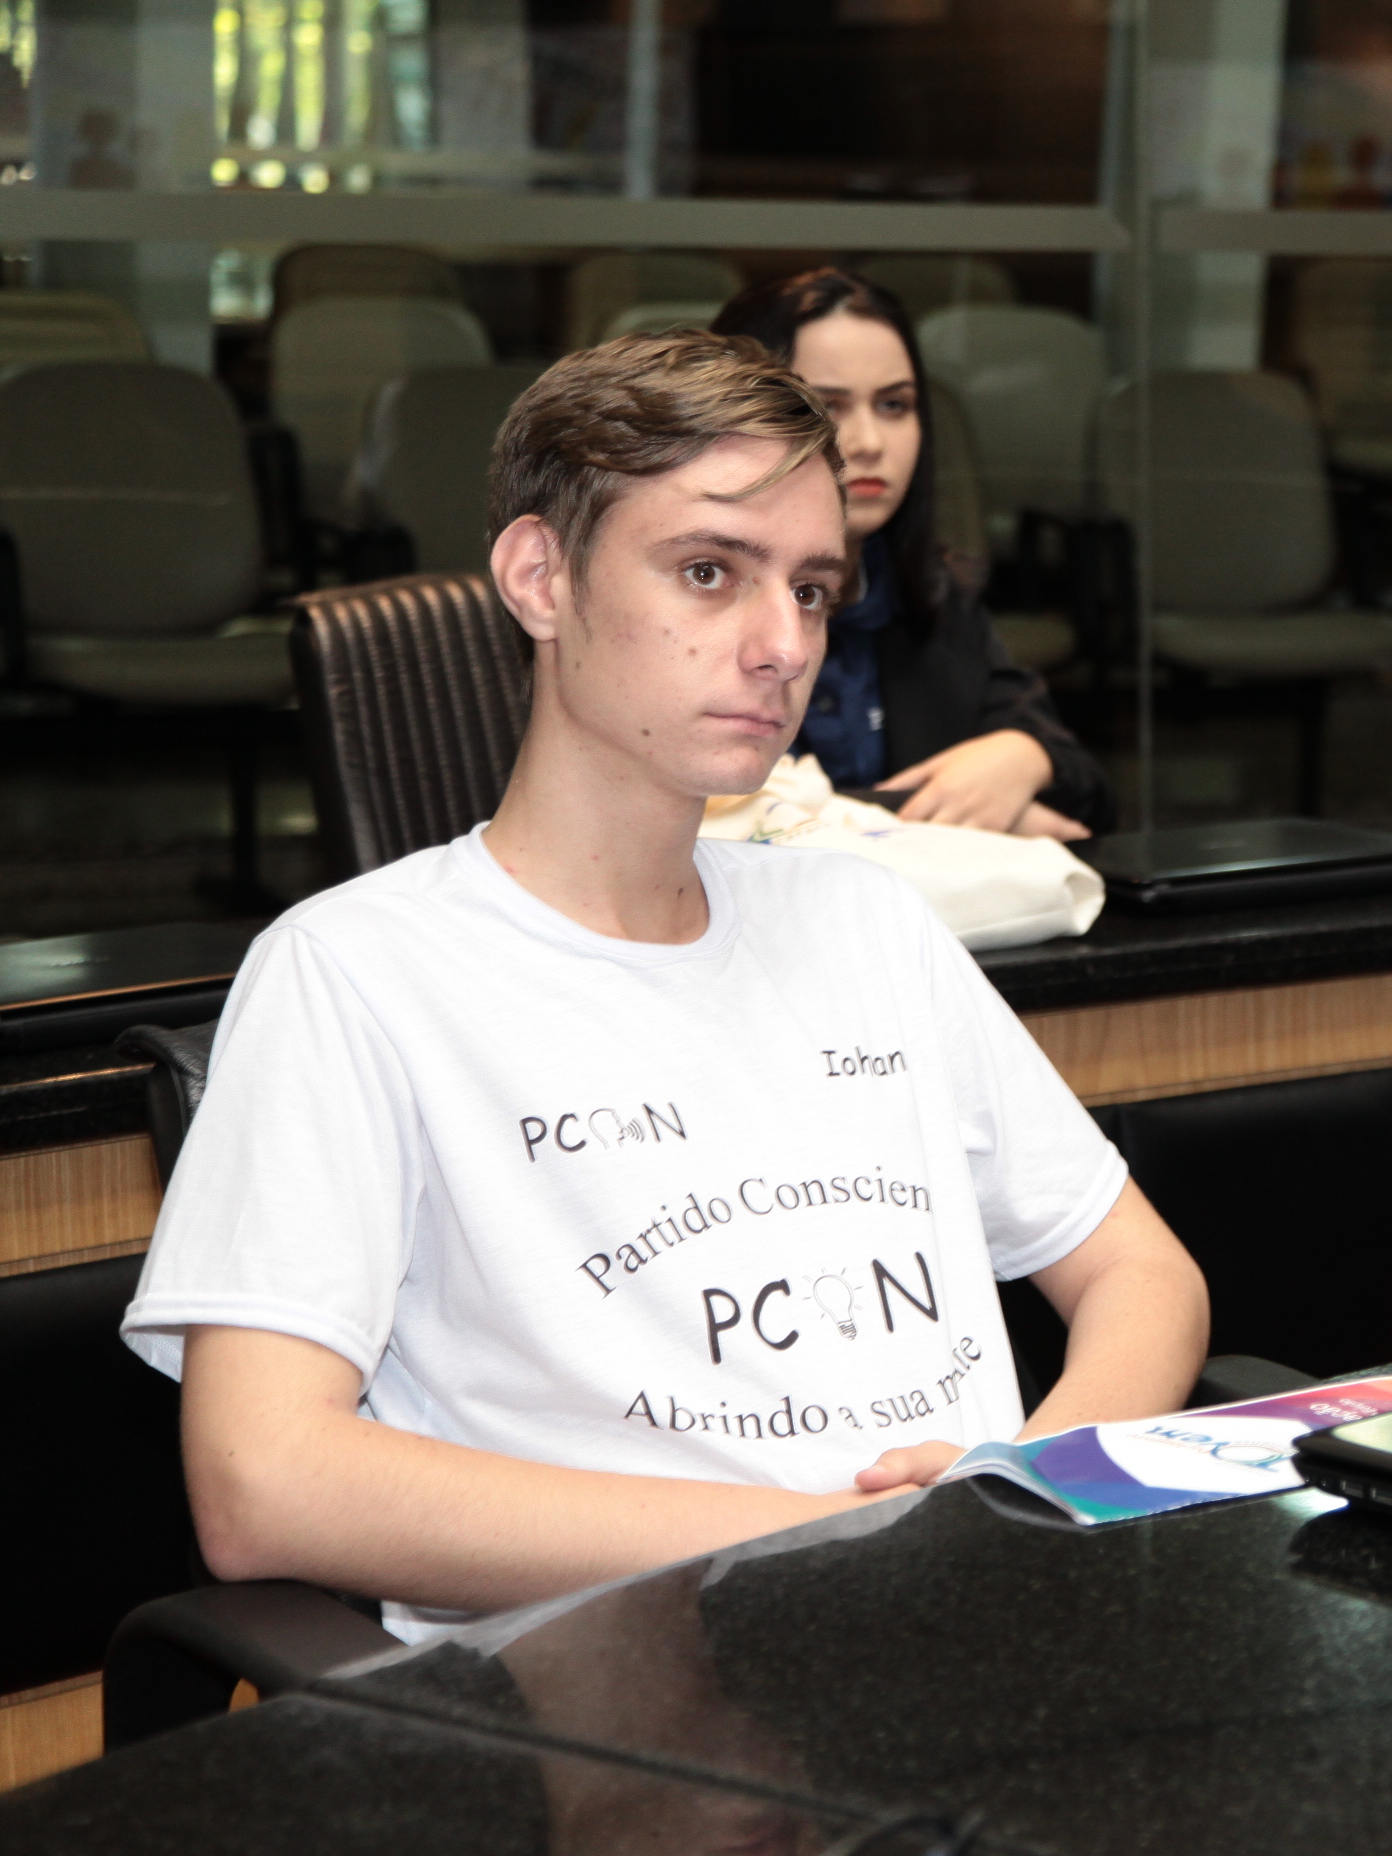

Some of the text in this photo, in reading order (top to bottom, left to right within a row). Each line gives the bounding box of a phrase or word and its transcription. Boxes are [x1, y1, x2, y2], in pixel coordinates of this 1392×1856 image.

[575, 1191, 733, 1299] Partido
[622, 1389, 829, 1440] Abrindo
[837, 1405, 863, 1430] a
[869, 1389, 935, 1429] sua
